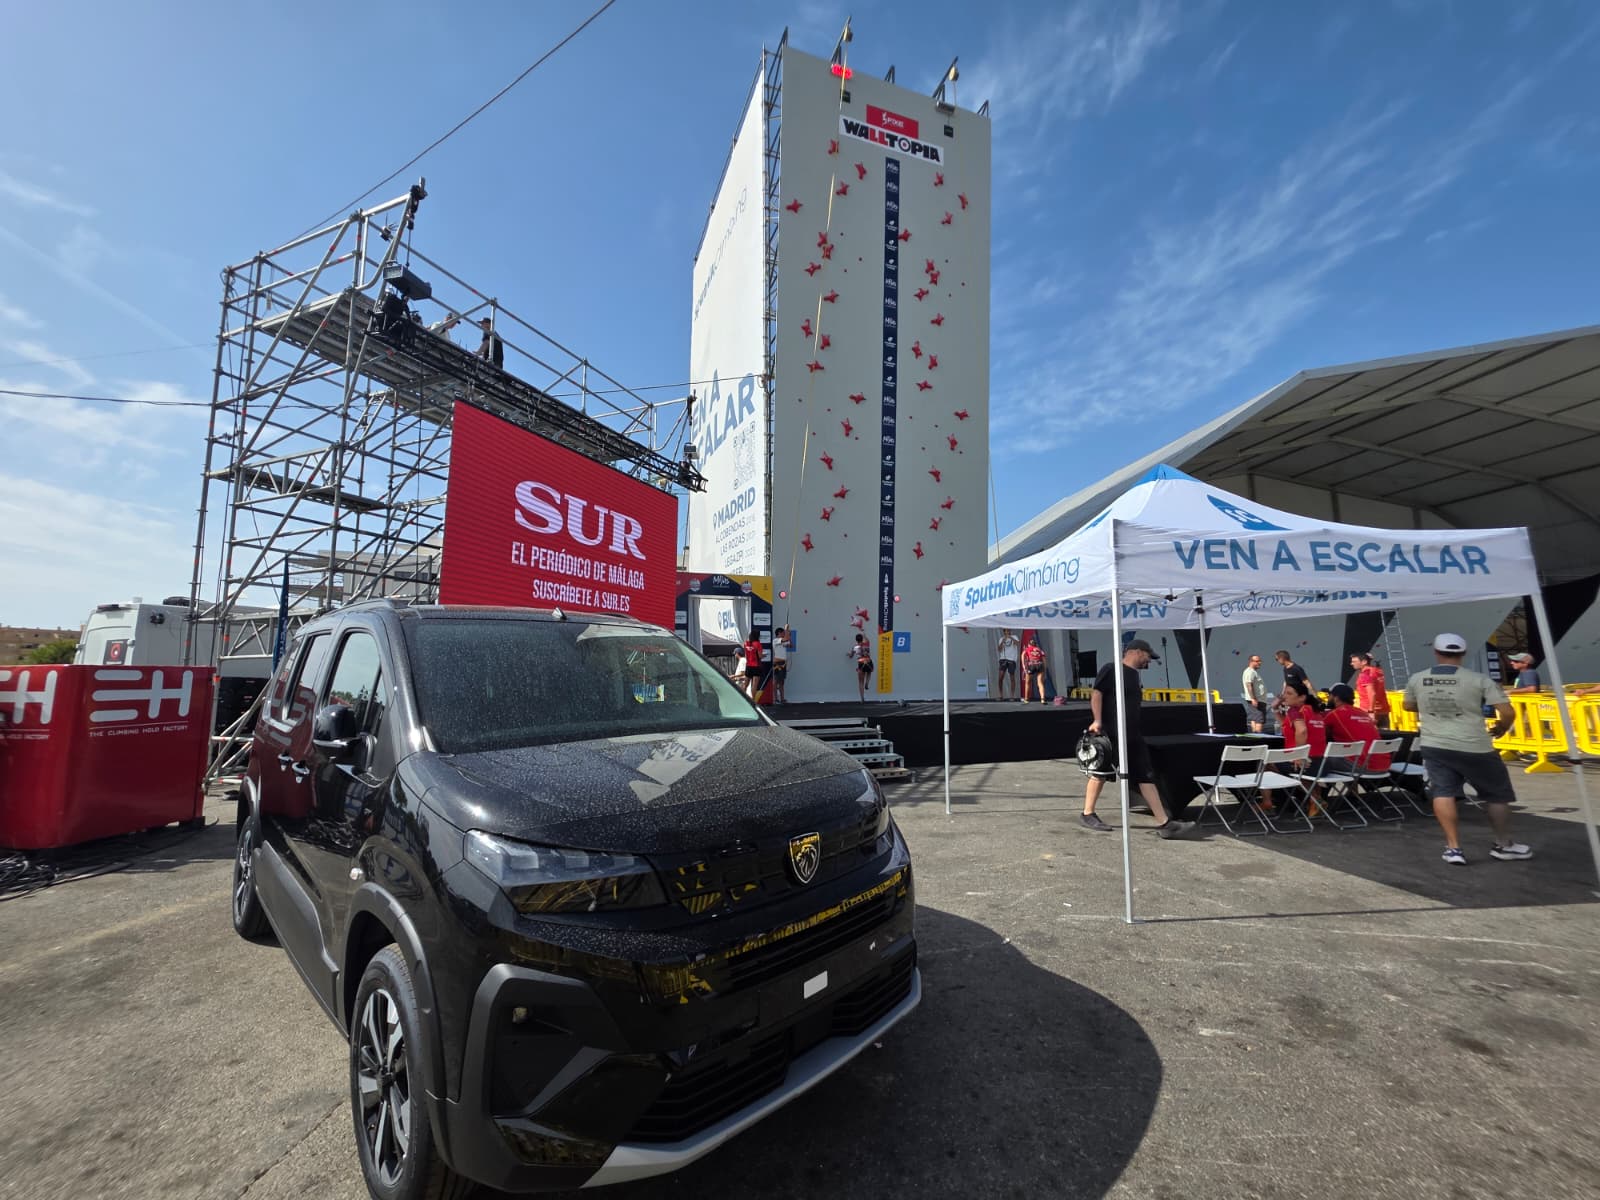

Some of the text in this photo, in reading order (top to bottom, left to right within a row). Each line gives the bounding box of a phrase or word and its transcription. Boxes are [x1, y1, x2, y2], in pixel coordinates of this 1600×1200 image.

[842, 118, 941, 162] WALLTOPIA
[514, 480, 647, 560] SUR
[717, 486, 756, 528] MADRID
[511, 541, 645, 590] EL PERIÓDICO DE MÁLAGA
[1173, 539, 1491, 575] VEN A ESCALAR
[532, 579, 630, 612] SUSCRÍBETE A SUR.ES
[964, 556, 1080, 609] SputnikClimbing
[896, 636, 906, 647] B
[107, 728, 139, 736] CLIMBING
